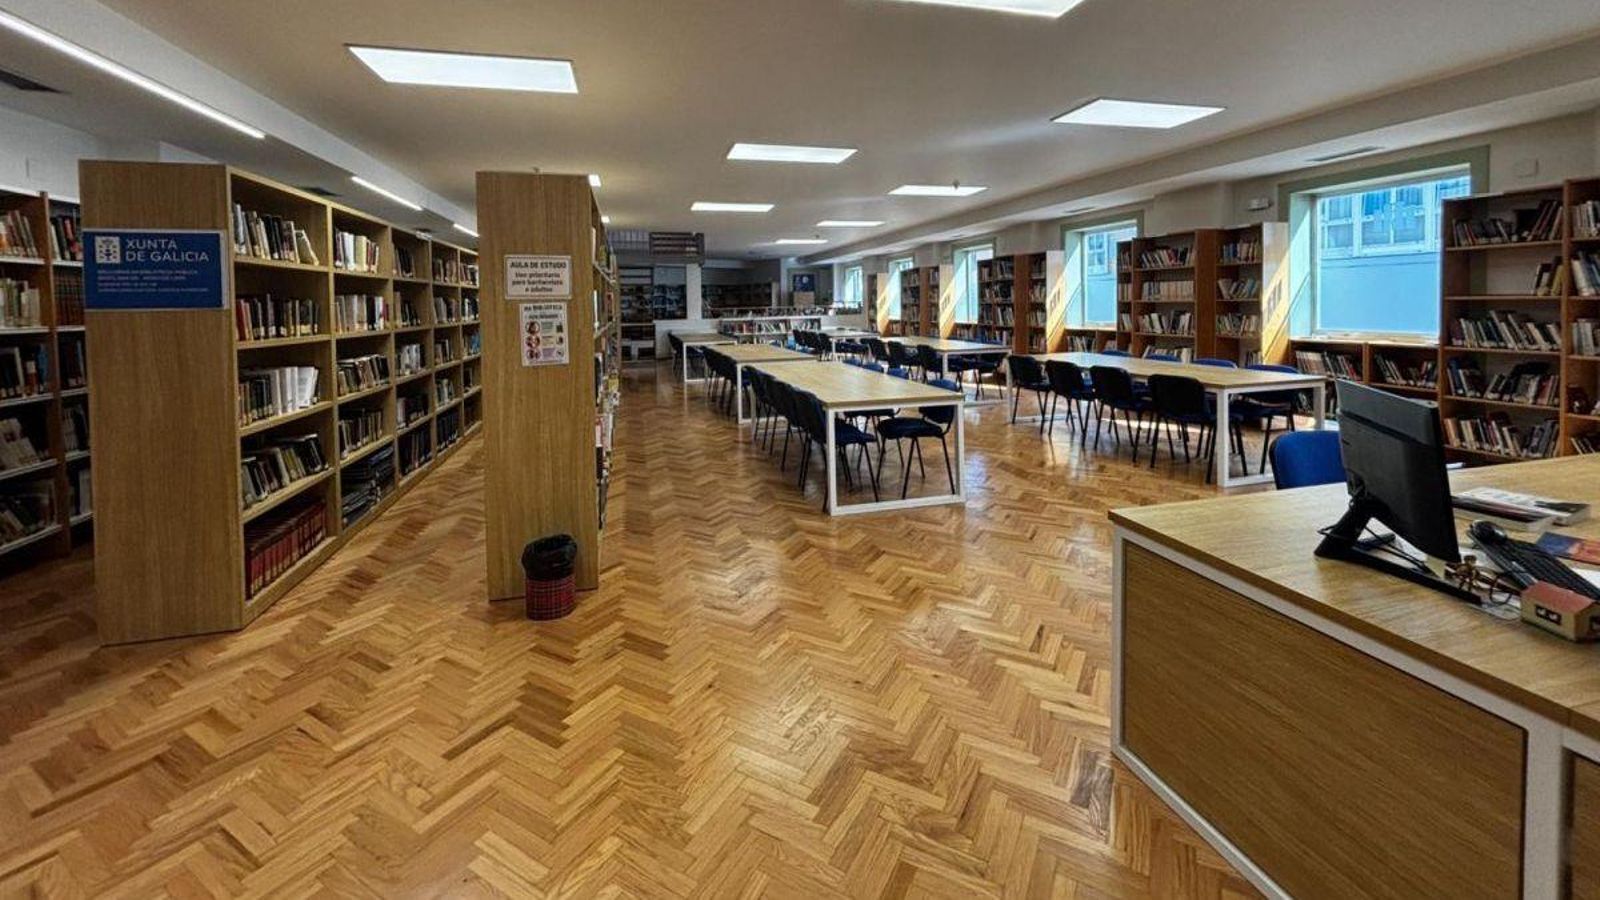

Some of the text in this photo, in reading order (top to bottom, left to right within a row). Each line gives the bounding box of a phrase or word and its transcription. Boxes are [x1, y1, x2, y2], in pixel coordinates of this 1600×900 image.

[126, 239, 178, 250] XUNTA
[126, 252, 209, 262] DE GALICIA
